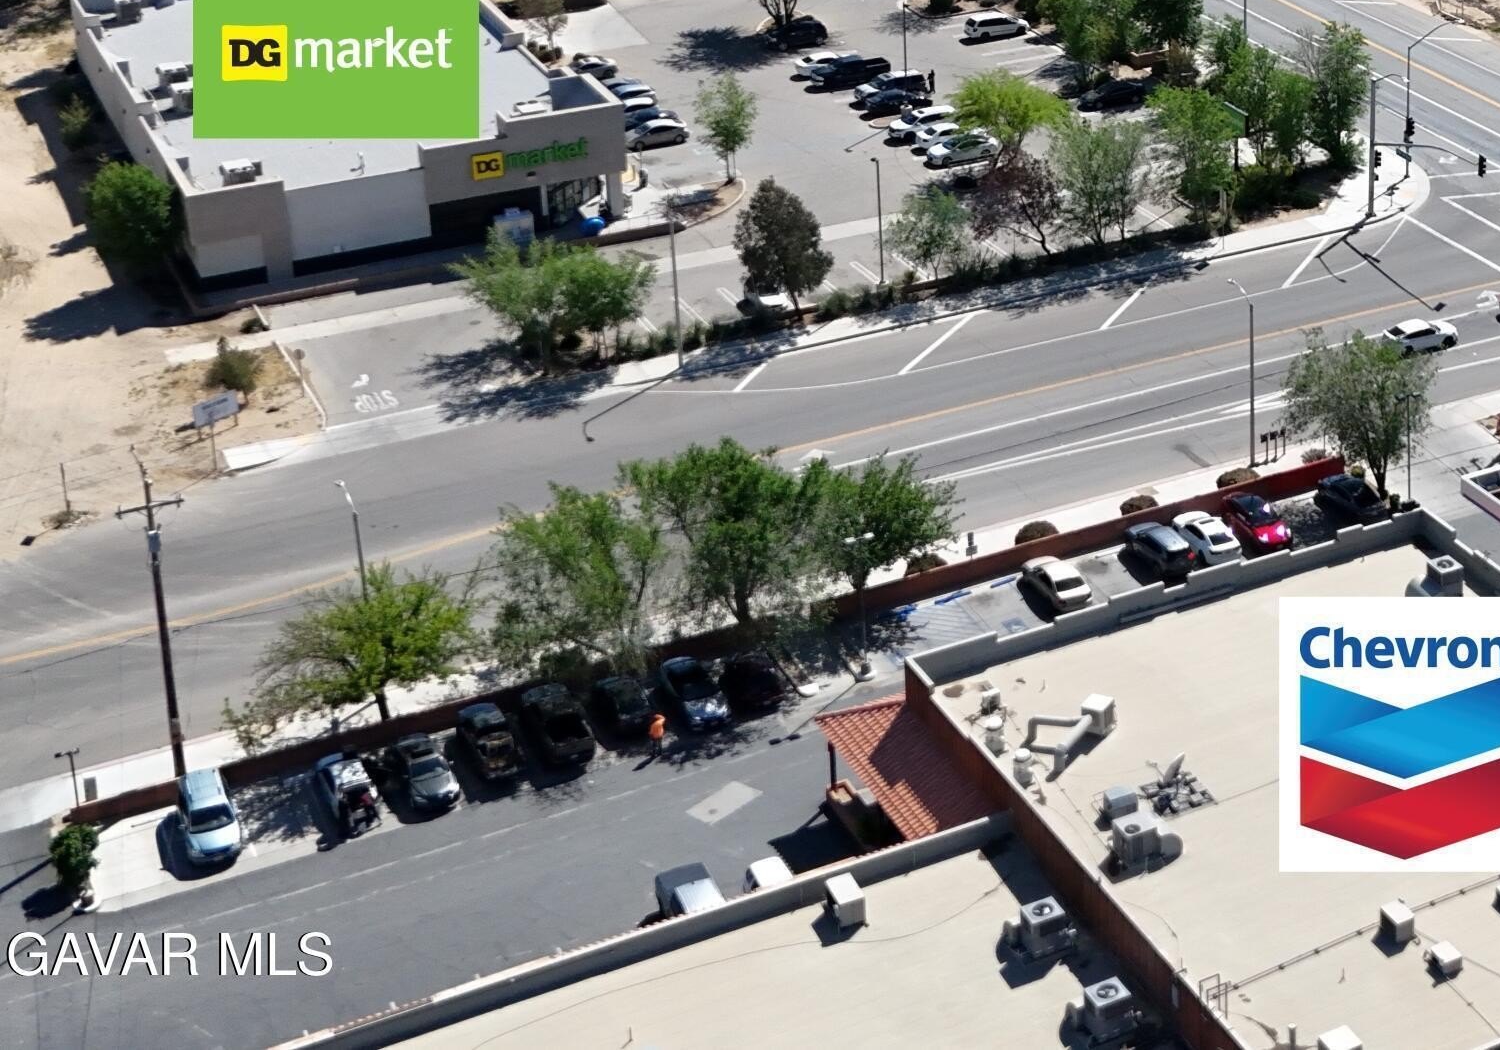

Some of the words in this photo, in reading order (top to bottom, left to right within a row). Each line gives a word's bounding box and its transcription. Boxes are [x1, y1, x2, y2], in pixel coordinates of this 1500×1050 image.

[475, 158, 501, 174] DG
[506, 136, 590, 169] market
[354, 389, 400, 413] STOP
